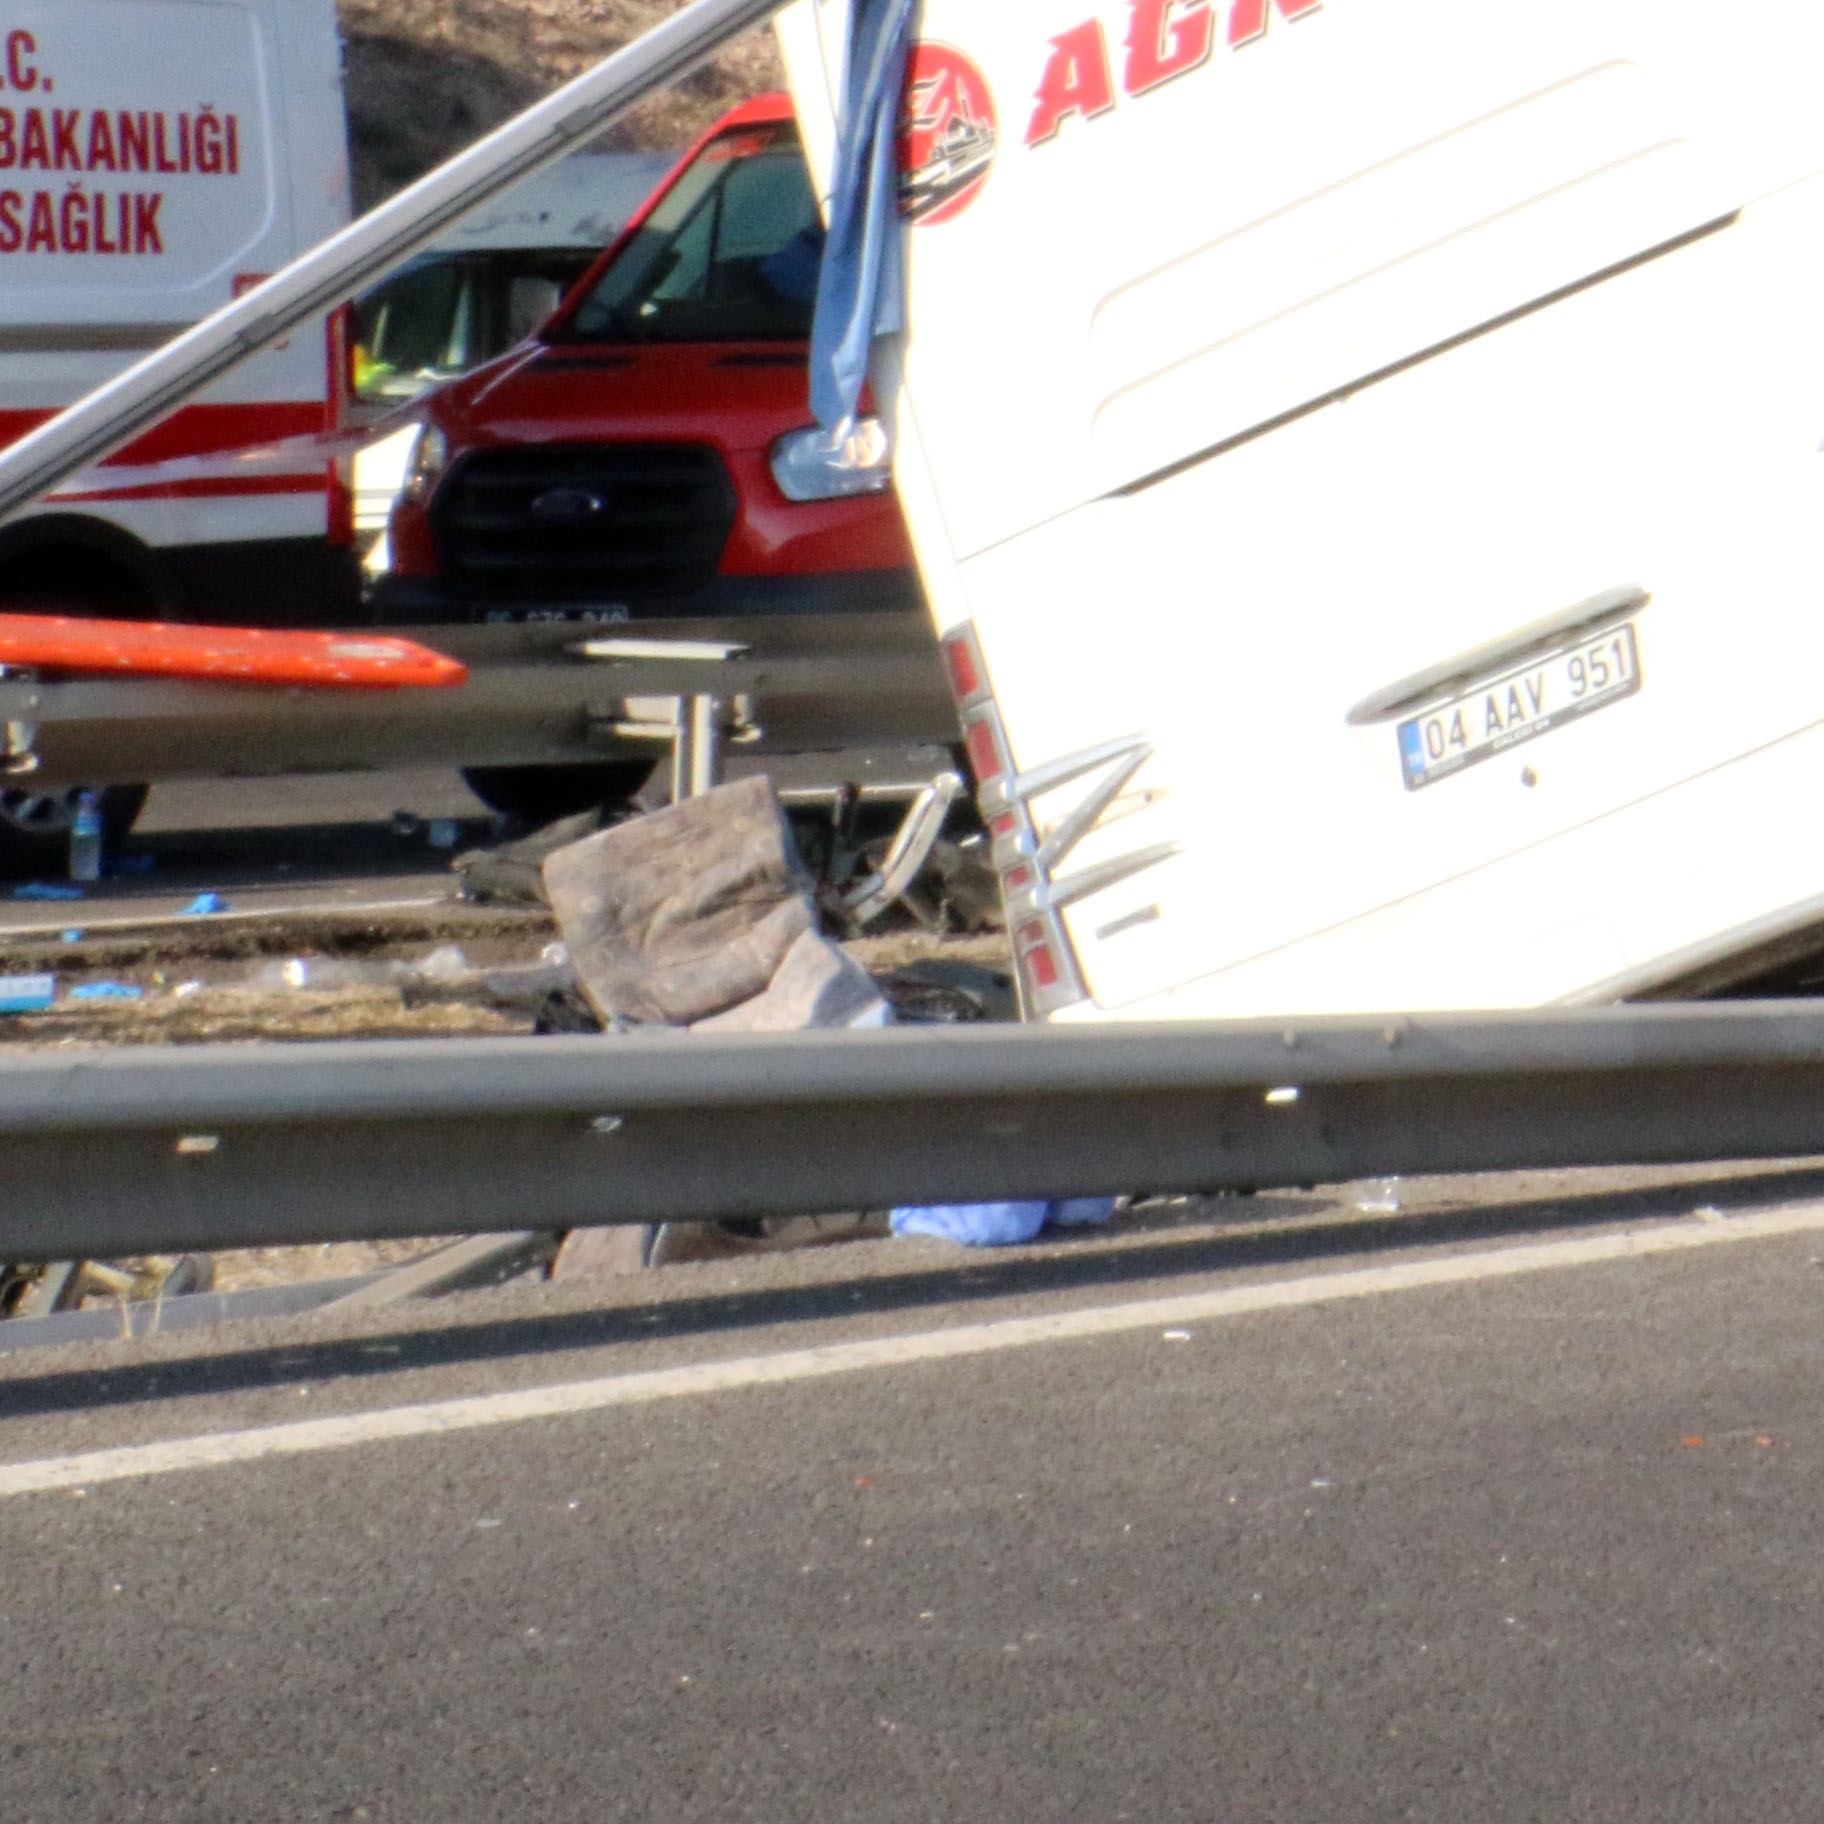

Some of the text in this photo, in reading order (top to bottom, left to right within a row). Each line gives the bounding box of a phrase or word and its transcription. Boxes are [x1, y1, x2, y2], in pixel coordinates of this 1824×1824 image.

[0, 102, 240, 175] BAKANLIĞI
[0, 180, 164, 255] SAĞLIK
[1425, 708, 1469, 760] 04
[1484, 672, 1545, 738] AAV
[1566, 637, 1627, 698] 951
